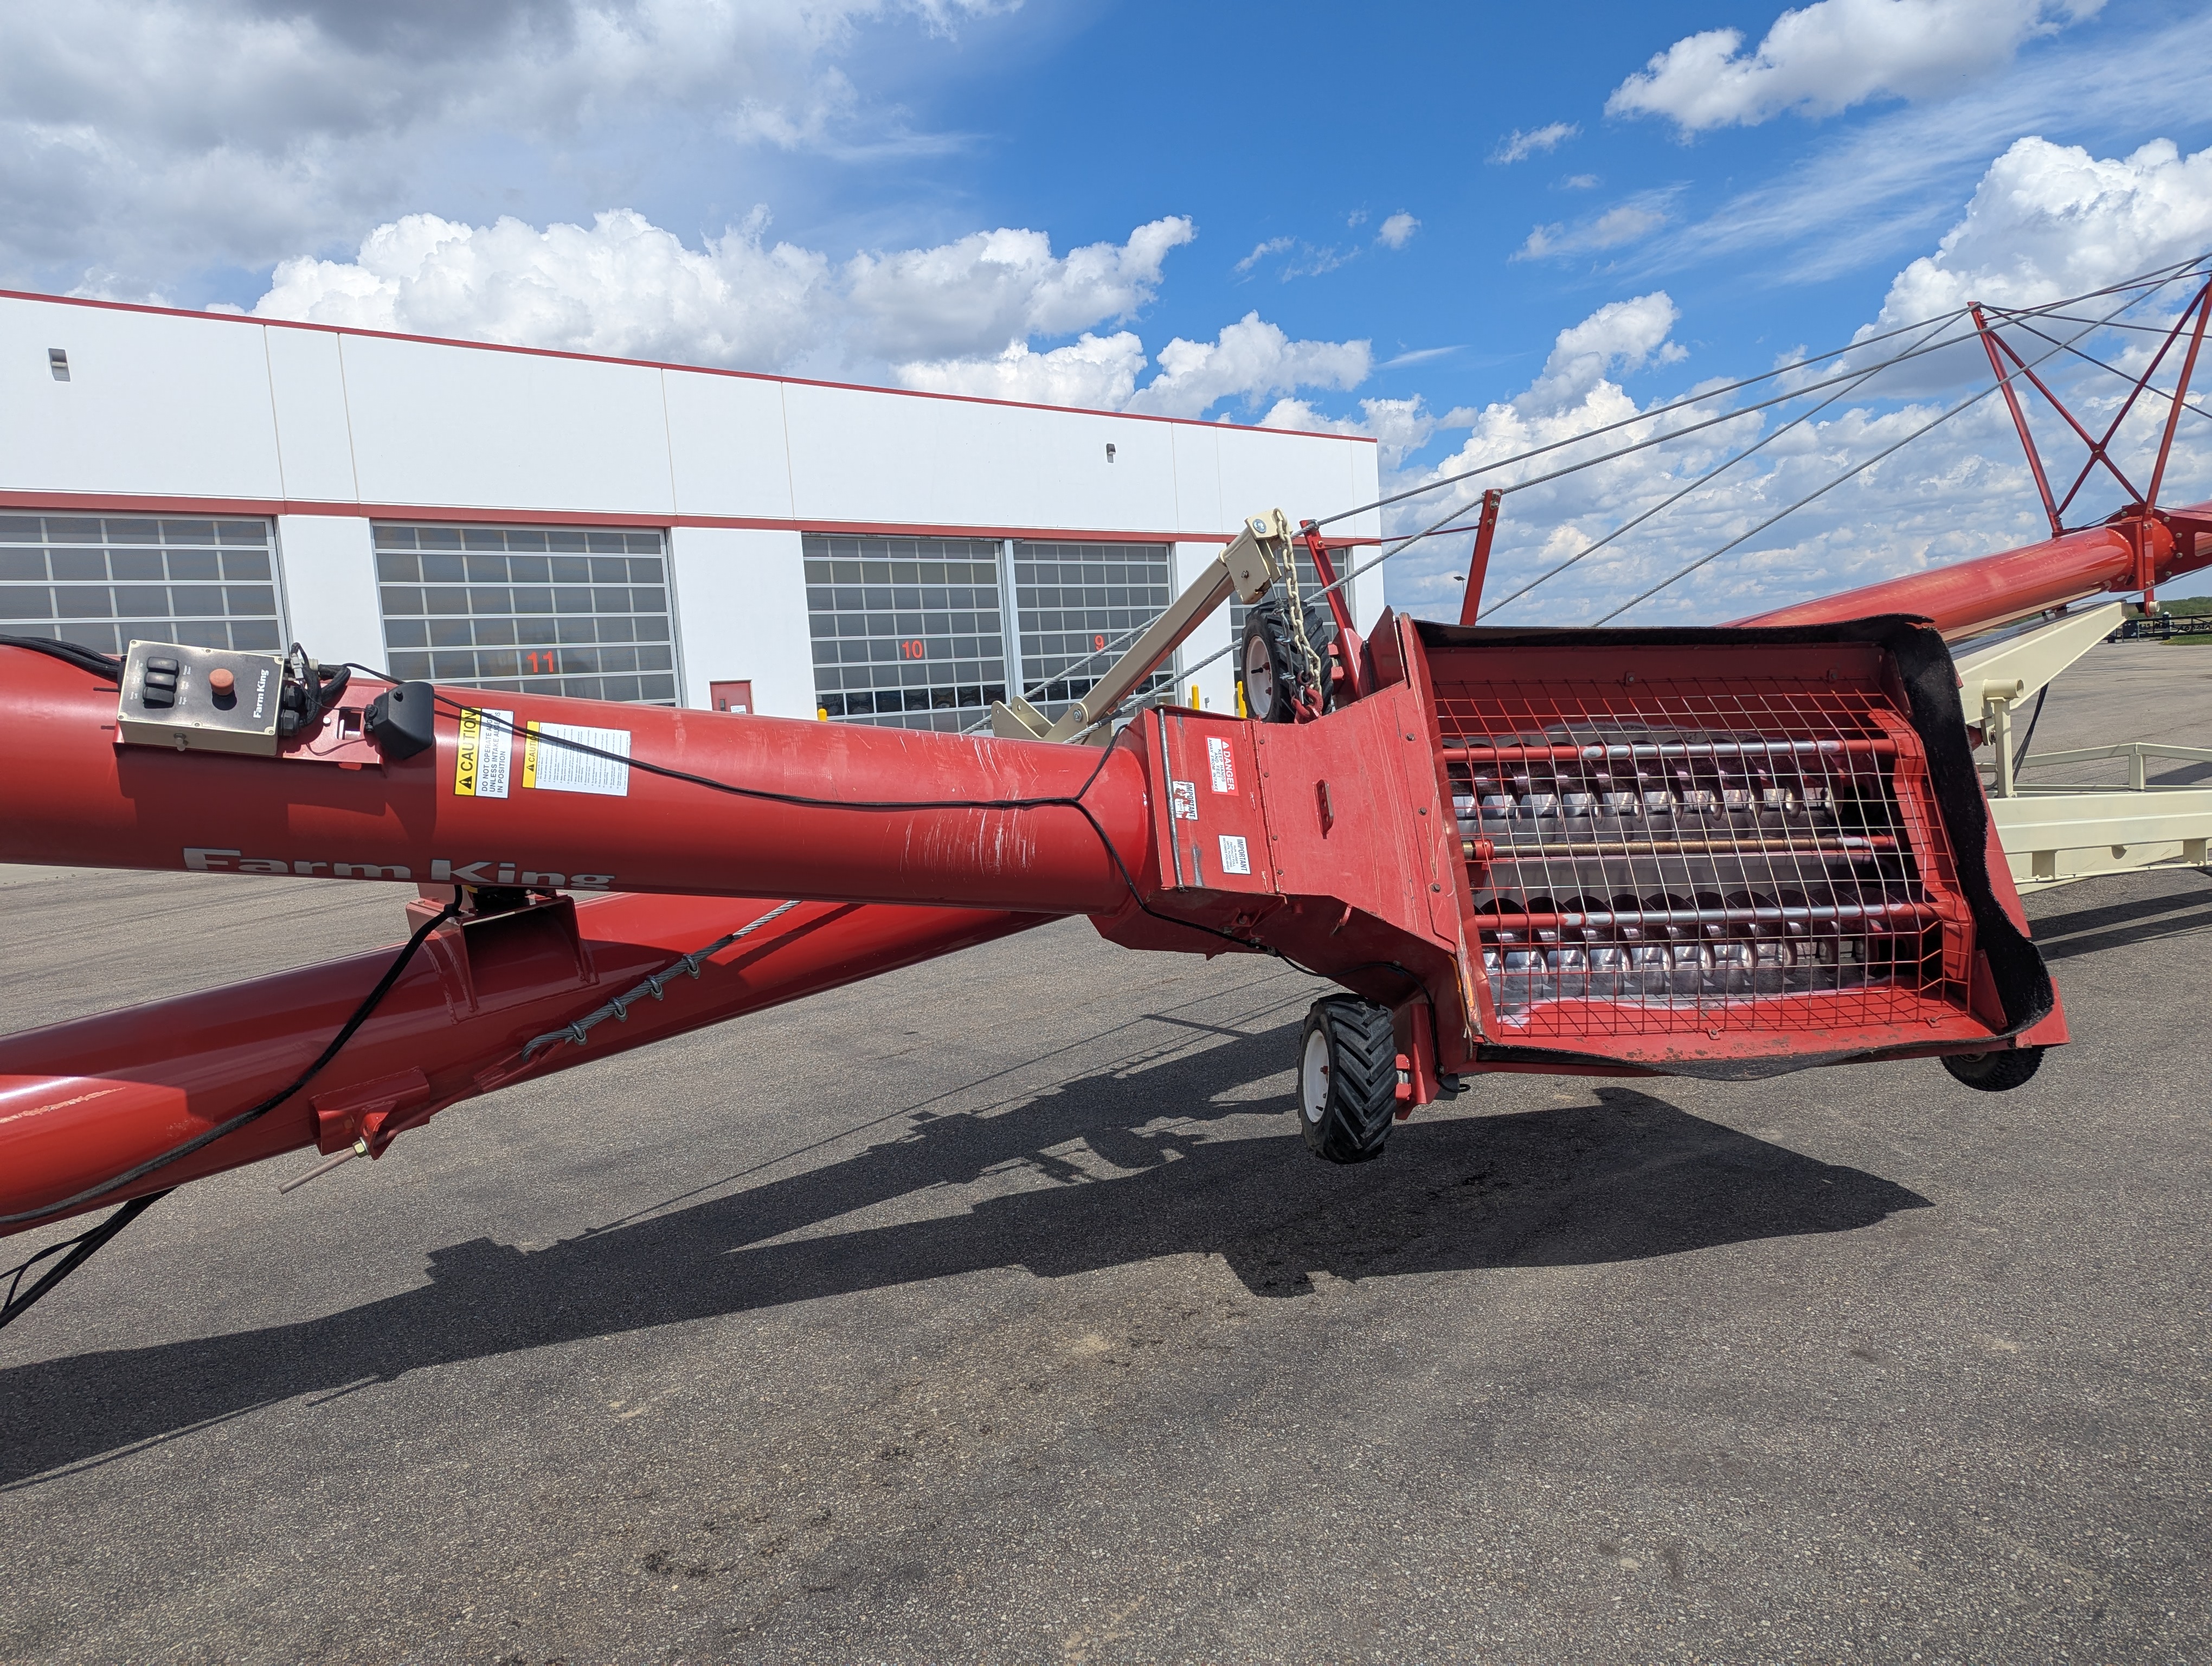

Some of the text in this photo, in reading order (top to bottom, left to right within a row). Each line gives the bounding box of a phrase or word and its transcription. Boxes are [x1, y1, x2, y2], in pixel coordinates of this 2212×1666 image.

[902, 640, 922, 658] 10
[1095, 635, 1104, 651] 9
[527, 651, 554, 672] 11
[253, 669, 269, 718] Farm King
[460, 713, 477, 772] CAUTION
[528, 733, 536, 762] CAUTIO
[489, 764, 497, 792] UNLESS
[1223, 751, 1235, 790] DANGER
[481, 781, 488, 792] DO
[1186, 784, 1196, 818] IMPORTANT
[183, 848, 615, 890] Farm King
[1237, 839, 1248, 872] IMPORTANT
